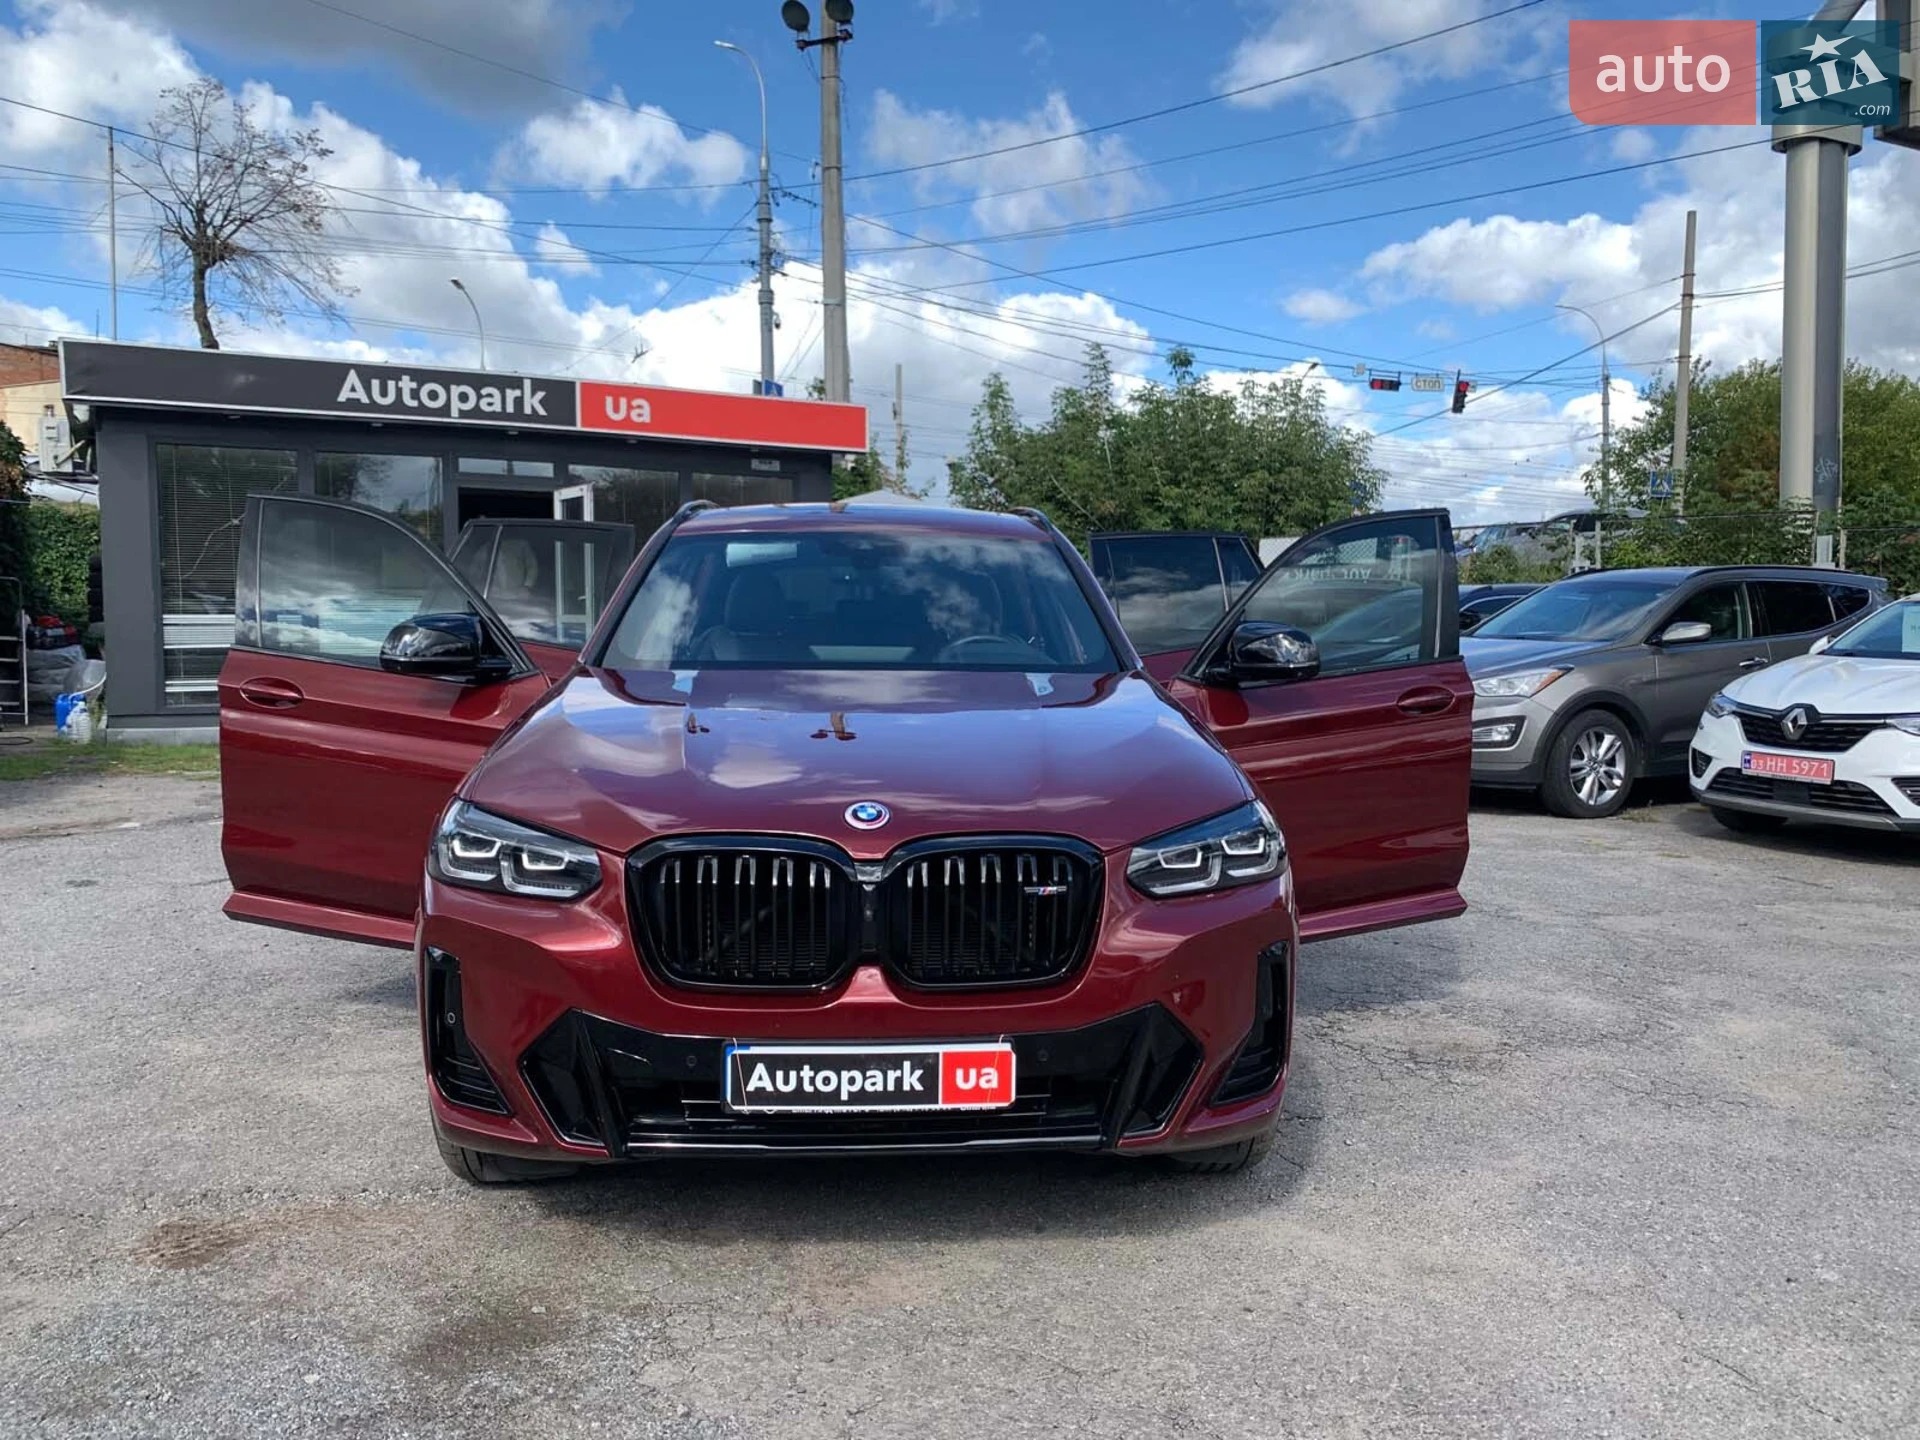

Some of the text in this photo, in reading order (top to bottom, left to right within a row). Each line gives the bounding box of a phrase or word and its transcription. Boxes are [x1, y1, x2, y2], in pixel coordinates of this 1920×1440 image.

[336, 368, 651, 423] Autopark ua
[1750, 759, 1764, 770] 03
[1792, 759, 1828, 777] 5971
[746, 1061, 999, 1101] Autopark ua
